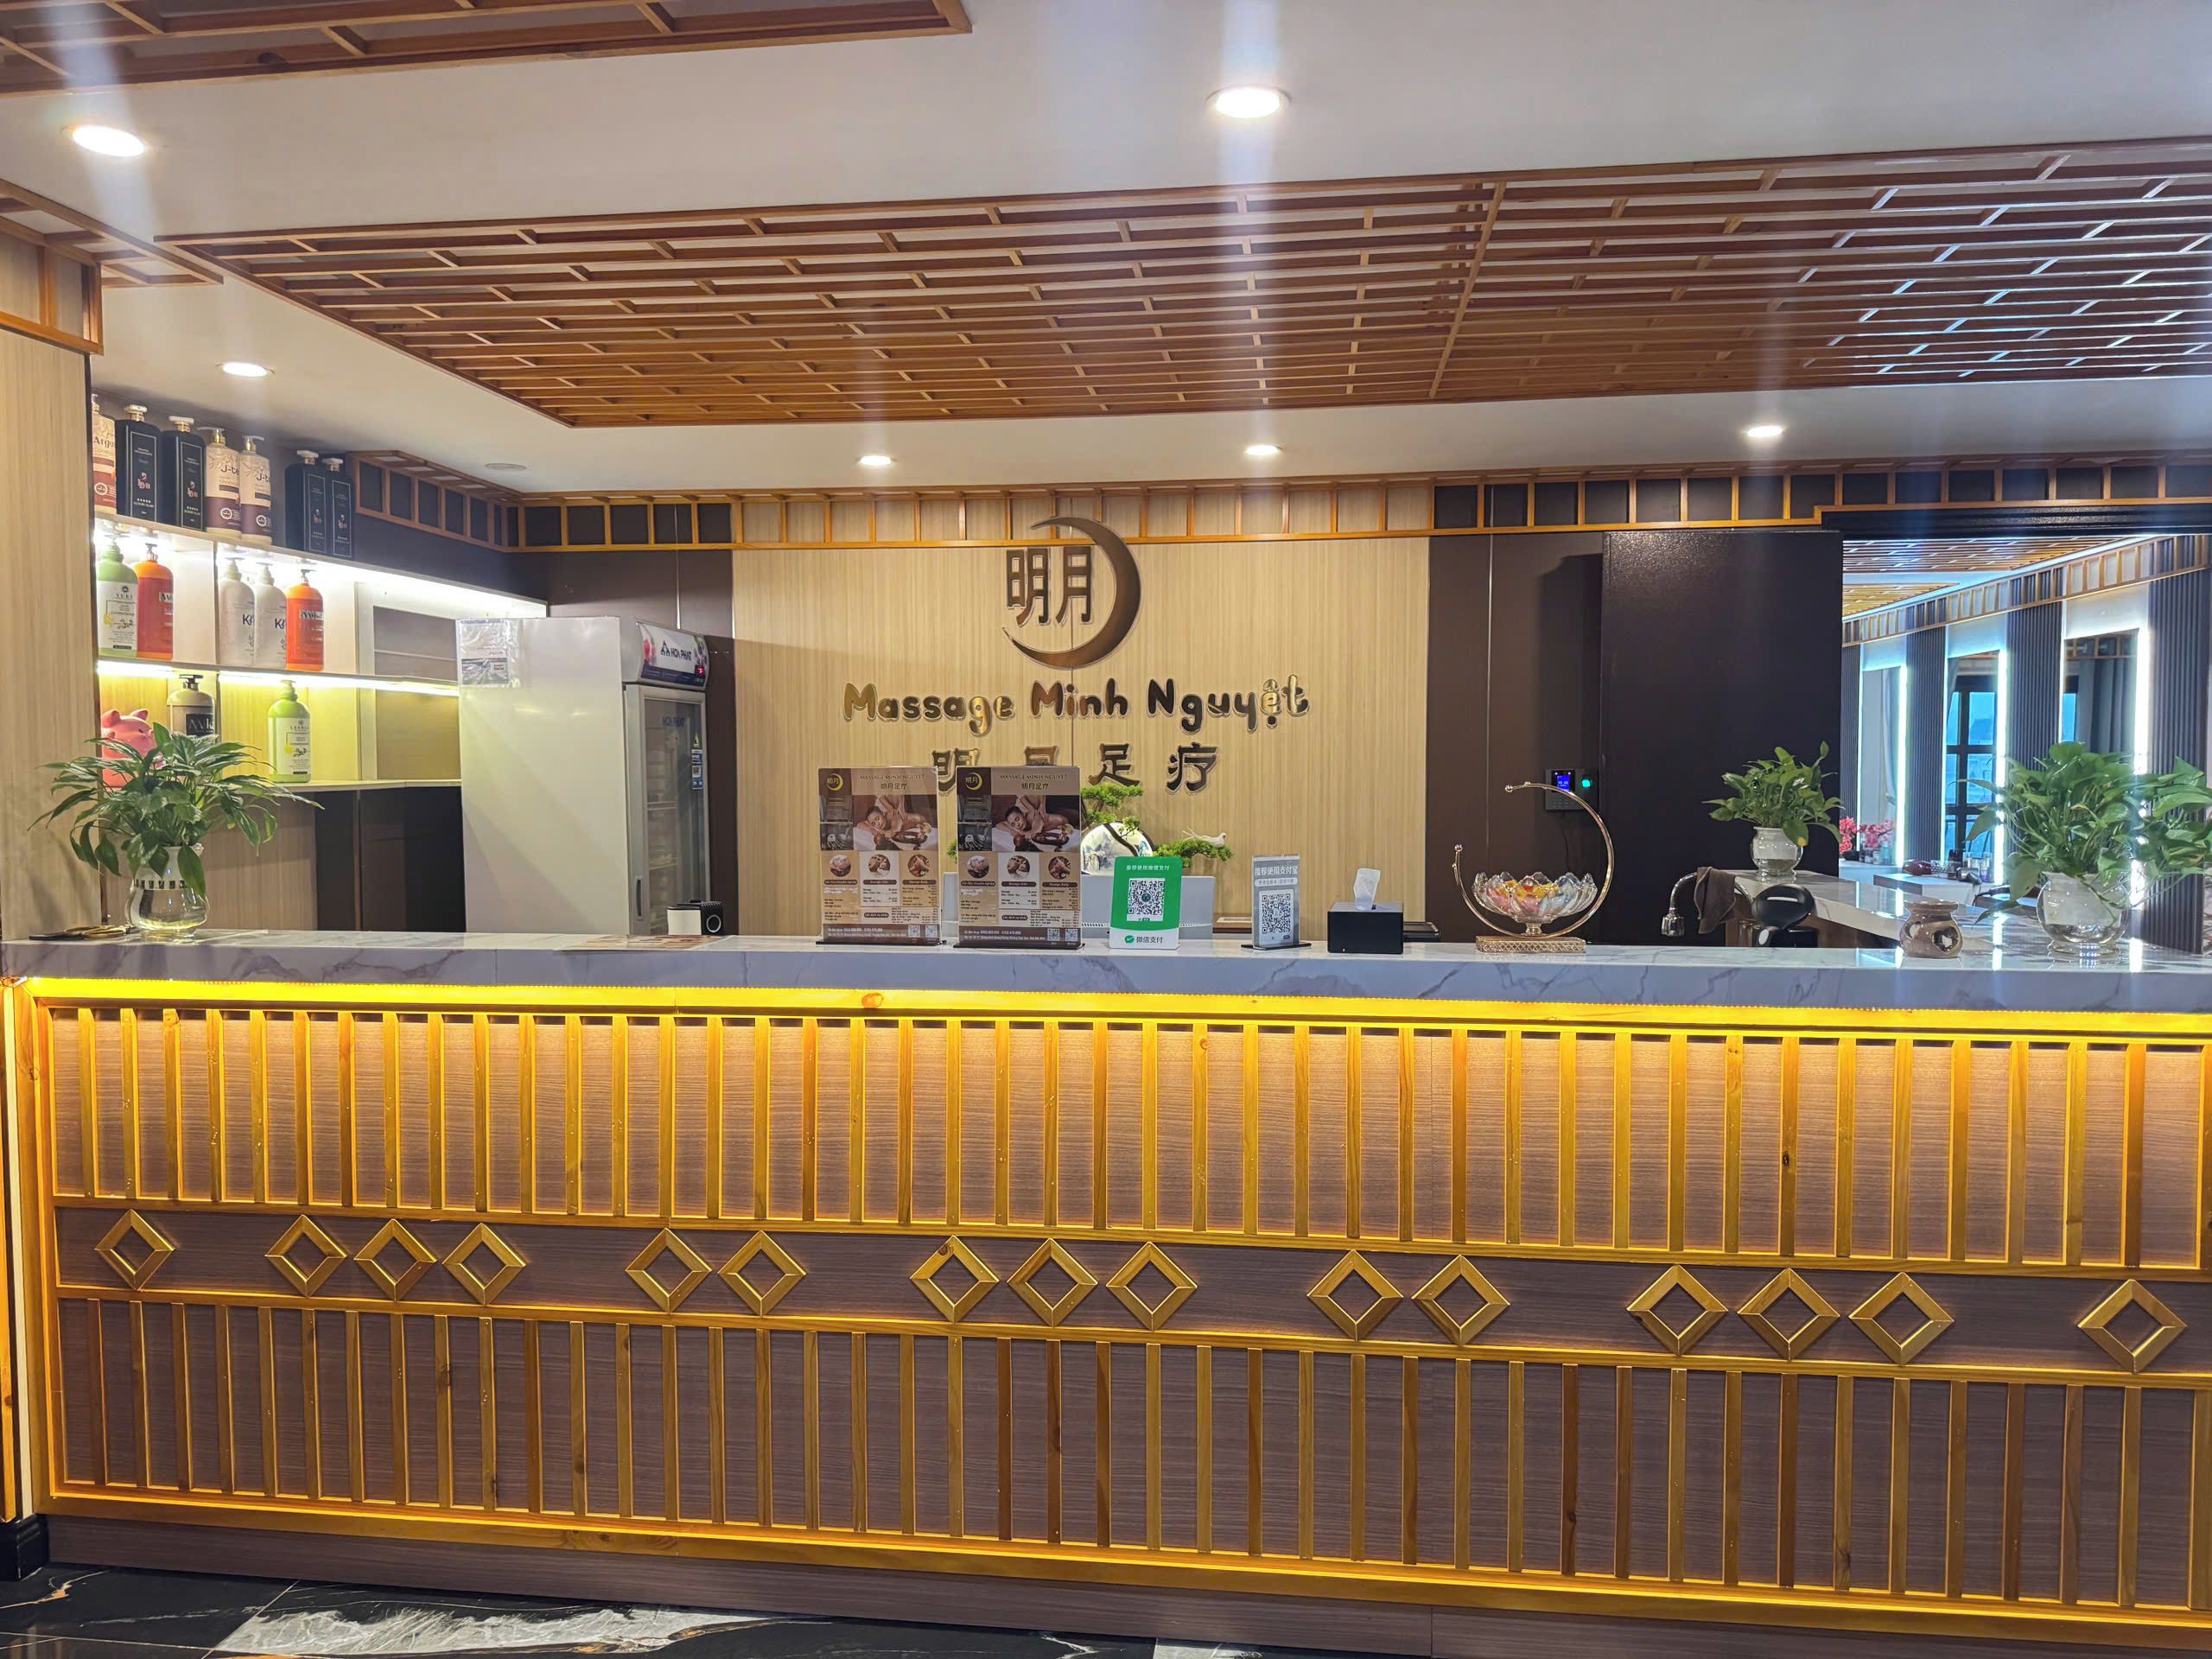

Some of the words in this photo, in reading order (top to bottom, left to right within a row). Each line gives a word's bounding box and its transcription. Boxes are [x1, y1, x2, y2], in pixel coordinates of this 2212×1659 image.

[1006, 546, 1093, 628] 明月
[843, 683, 1015, 737] Massage
[1030, 677, 1130, 720] Minh
[1147, 674, 1310, 734] Nguyệt
[880, 782, 908, 791] 明月足疗
[1021, 782, 1049, 791] 明月足疗
[1255, 866, 1299, 876] 推荐使用支付宝
